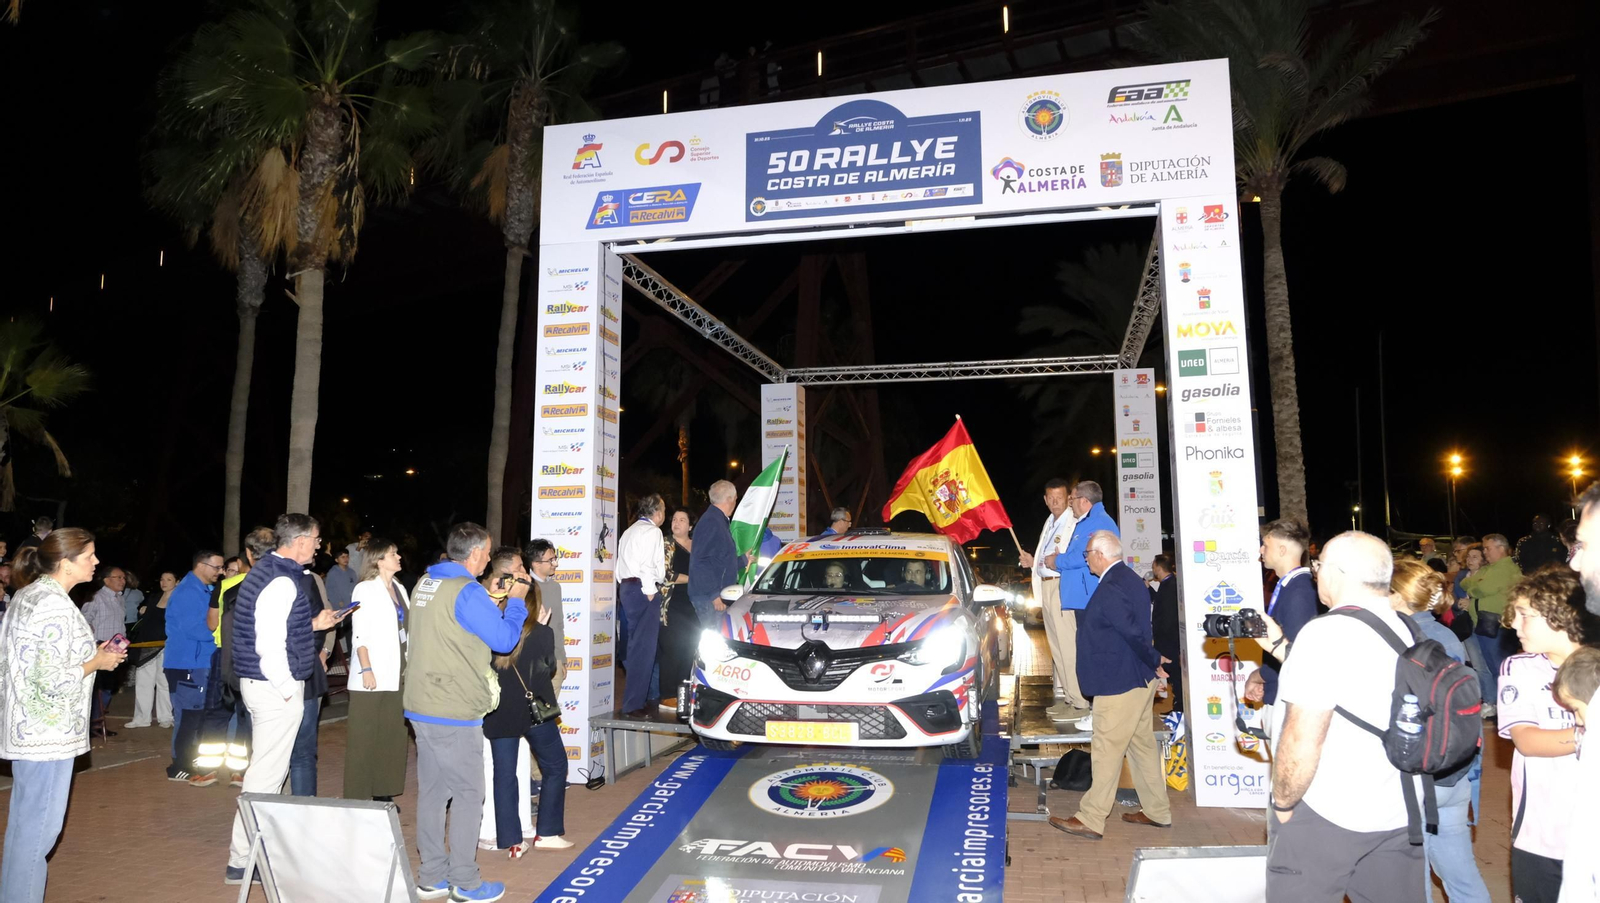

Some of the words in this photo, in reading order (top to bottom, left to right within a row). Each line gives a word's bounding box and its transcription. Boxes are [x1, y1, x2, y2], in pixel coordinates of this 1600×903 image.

[1054, 97, 1067, 111] CLUB
[848, 121, 872, 129] RALLYE
[767, 150, 810, 174] 50
[813, 136, 959, 170] RALLYE
[1129, 154, 1211, 172] DIPUTACIÓN
[766, 173, 830, 191] COSTA
[833, 172, 860, 186] DE
[864, 162, 956, 183] ALMERÍA
[1028, 166, 1068, 178] COSTA
[1070, 165, 1085, 175] DE
[1130, 173, 1147, 184] DE
[1150, 168, 1209, 183] ALMERÍA
[1017, 174, 1087, 194] ALMERÍA
[628, 188, 687, 205] CERA
[640, 209, 675, 220] Recalvi
[553, 326, 581, 335] Recalvi
[1176, 320, 1238, 339] MOYA
[1181, 358, 1205, 368] UNED
[1181, 383, 1241, 402] gasolia
[550, 407, 579, 416] Recalvi
[1206, 417, 1241, 425] Fornieles
[1121, 438, 1153, 447] MOYA
[1185, 445, 1245, 461] Phonika
[1122, 472, 1155, 482] gasolia
[547, 488, 576, 497] Recalvi
[1124, 505, 1156, 514] Phonika
[712, 663, 752, 682] AGRO
[1211, 674, 1246, 682] MARCAOR
[767, 767, 854, 783] AUTOMOVIL
[862, 772, 886, 788] CLUB
[1205, 773, 1265, 796] argar
[698, 838, 907, 863] FACV
[696, 855, 763, 865] FEDERACIÓN
[764, 857, 777, 865] DE
[779, 858, 867, 869] AUTOMOVILISMO
[773, 864, 838, 872] COMUNITAT
[841, 866, 906, 876] VALENCIANA
